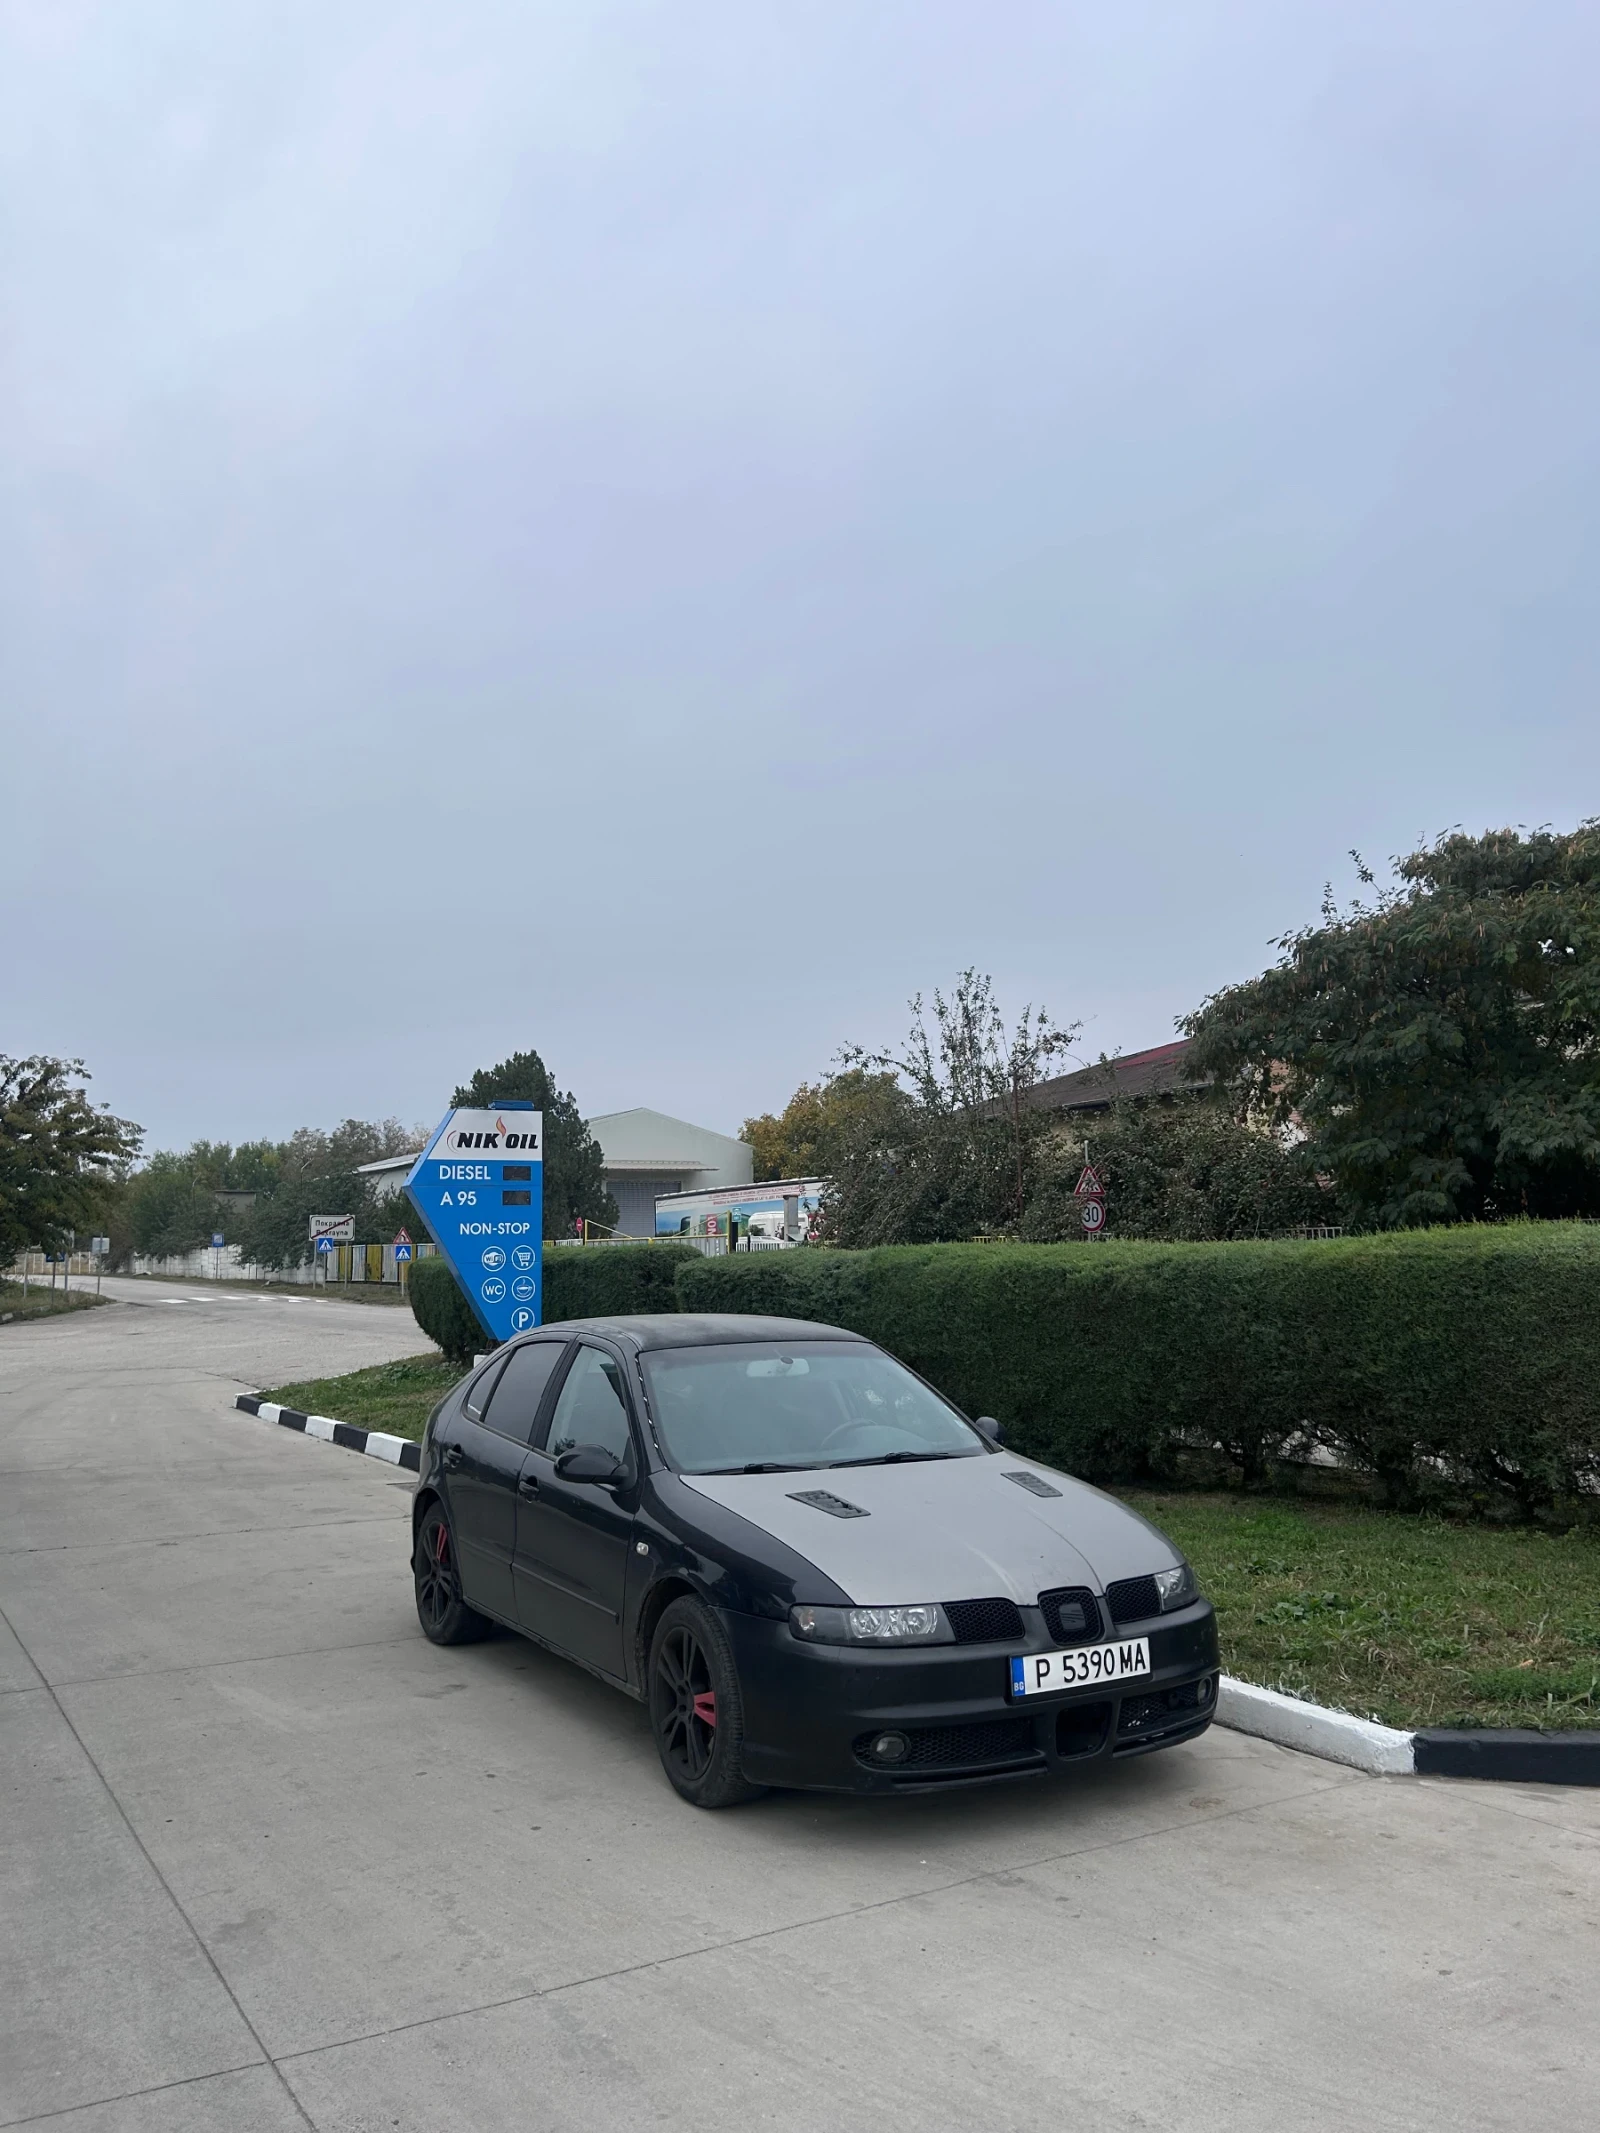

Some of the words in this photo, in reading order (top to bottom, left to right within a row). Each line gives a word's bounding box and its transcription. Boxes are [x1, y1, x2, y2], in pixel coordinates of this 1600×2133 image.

[439, 1165, 491, 1180] DIESEL
[440, 1191, 453, 1206] A
[457, 1191, 477, 1206] 95
[1083, 1206, 1099, 1223] 30
[315, 1219, 350, 1227] Покрана
[459, 1222, 530, 1235] NON-STOP
[485, 1285, 503, 1296] WC
[518, 1311, 529, 1328] P
[1035, 1658, 1050, 1688] P
[1062, 1648, 1115, 1683] 5390
[1119, 1643, 1146, 1674] MA
[1014, 1681, 1025, 1691] BG
